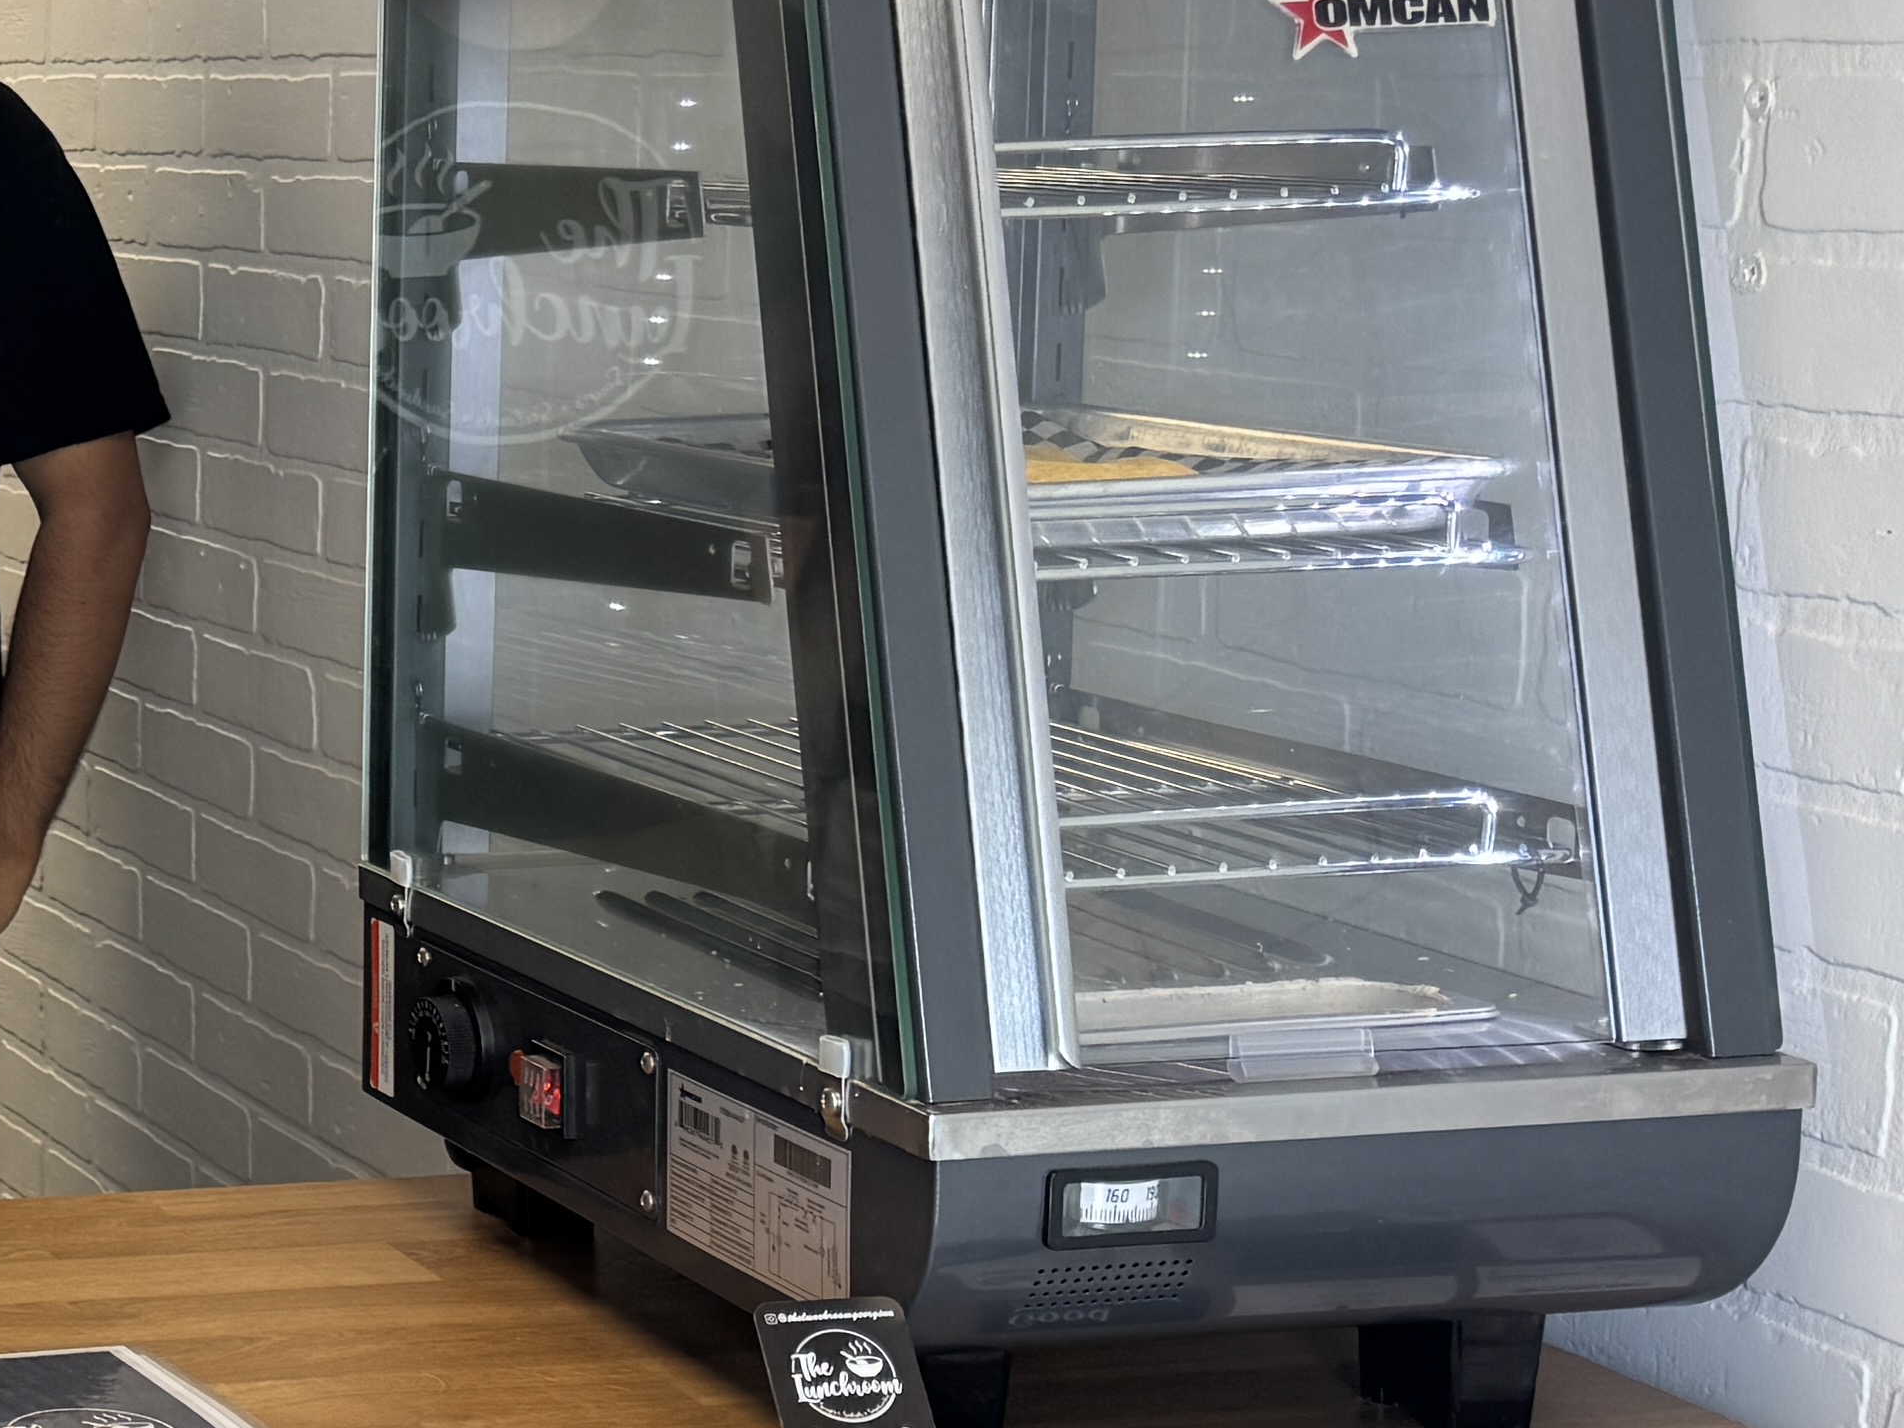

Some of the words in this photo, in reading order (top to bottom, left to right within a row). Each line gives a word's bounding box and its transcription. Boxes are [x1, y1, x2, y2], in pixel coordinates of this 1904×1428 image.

[1105, 1188, 1130, 1203] 160
[790, 1351, 834, 1382] The
[791, 1370, 903, 1403] Lunchroom
